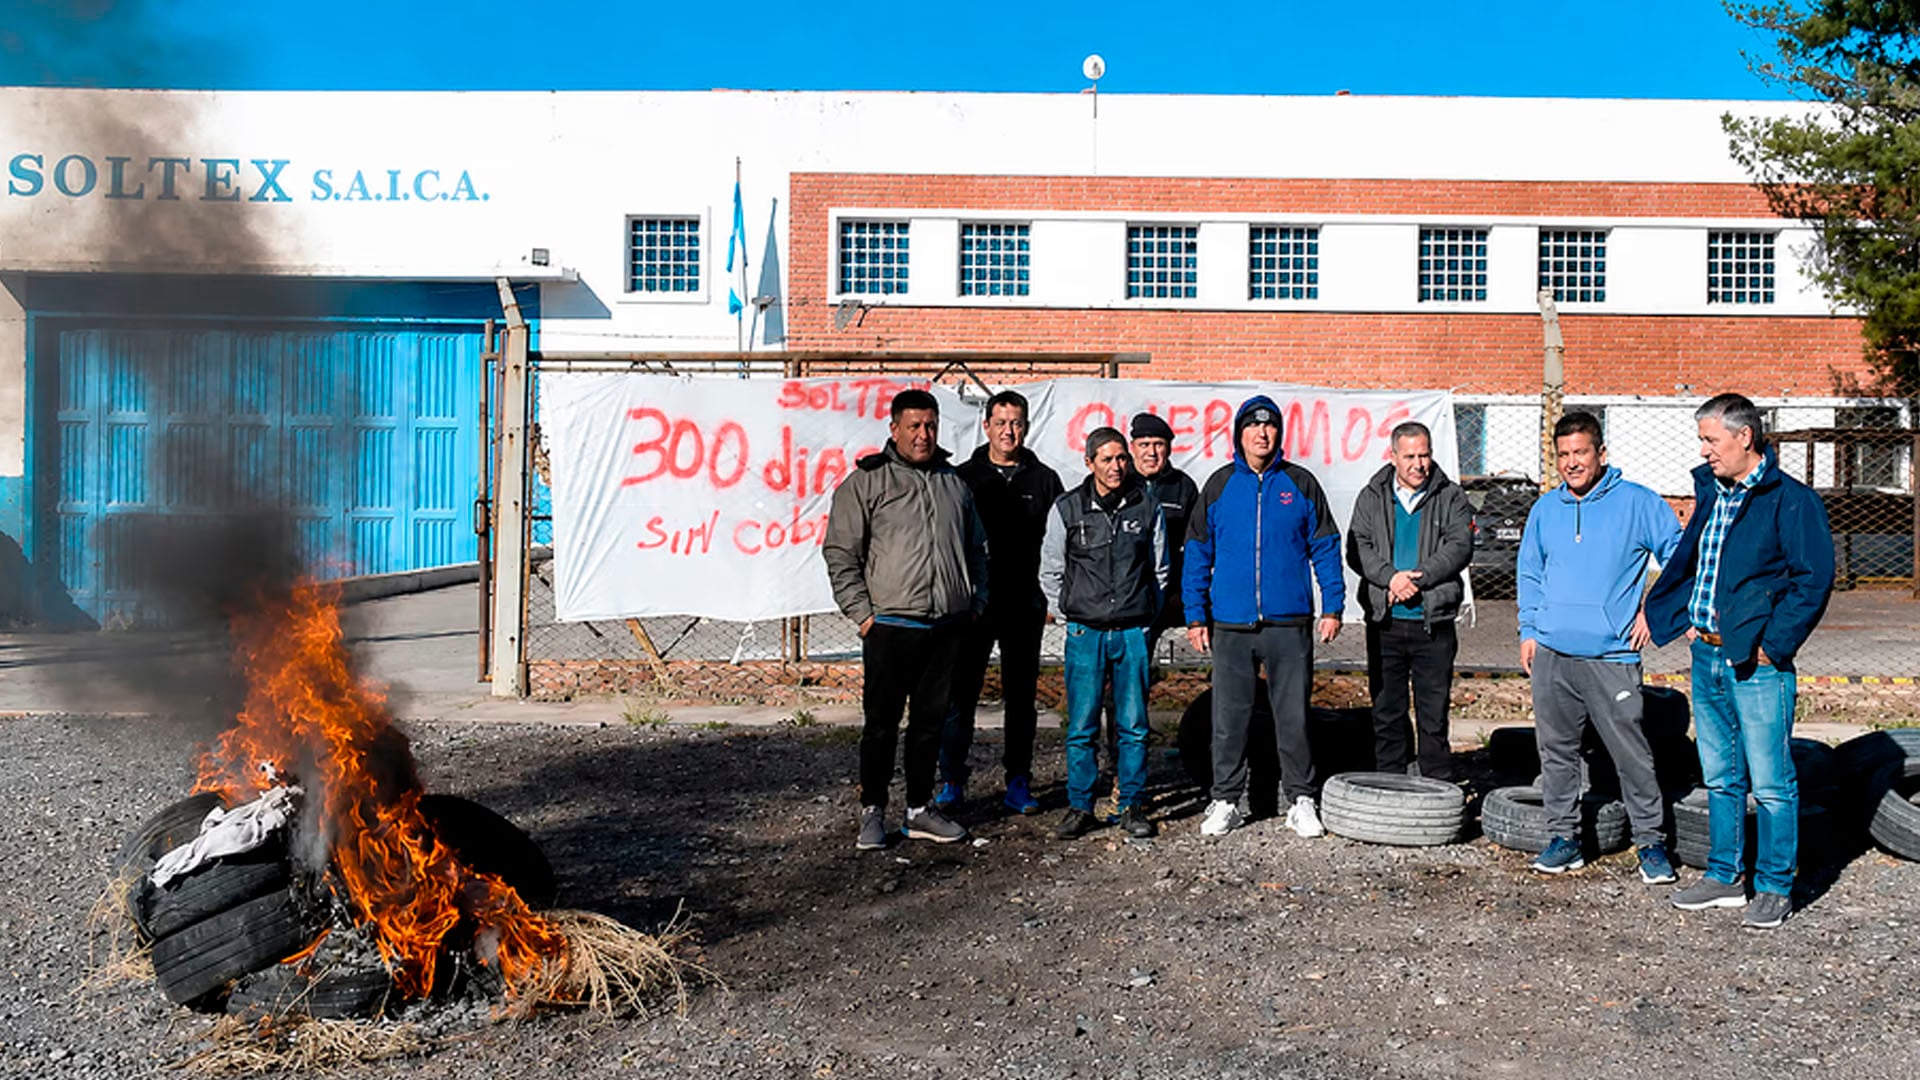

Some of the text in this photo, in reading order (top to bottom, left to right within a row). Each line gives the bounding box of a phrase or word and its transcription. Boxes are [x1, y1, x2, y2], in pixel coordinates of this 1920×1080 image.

[8, 154, 490, 203] SOLTEX S.A.I.C.A.
[621, 407, 749, 489] 300
